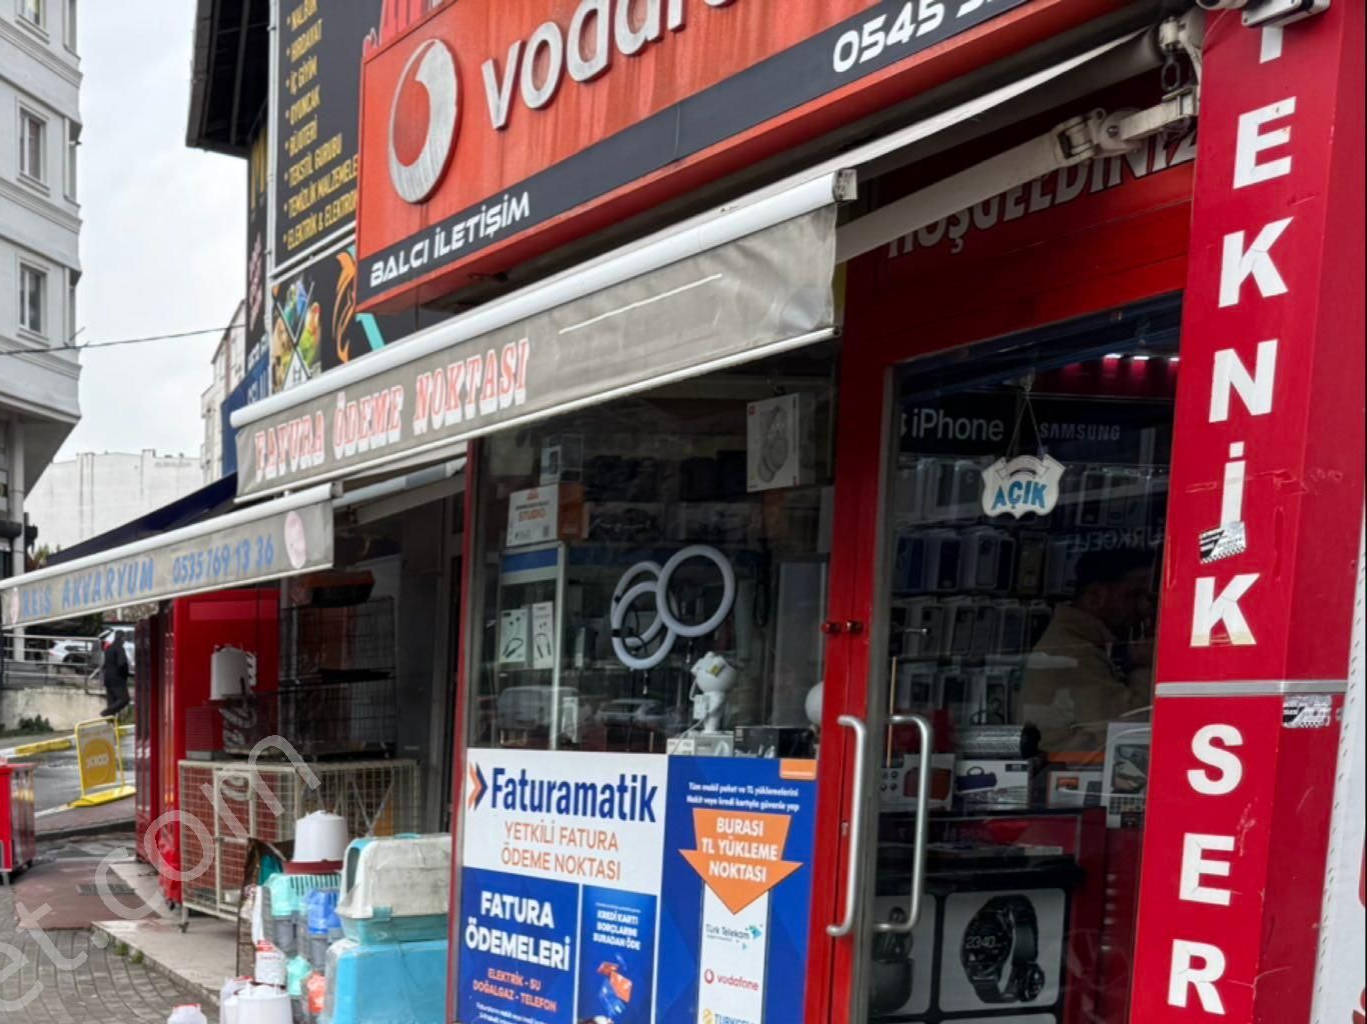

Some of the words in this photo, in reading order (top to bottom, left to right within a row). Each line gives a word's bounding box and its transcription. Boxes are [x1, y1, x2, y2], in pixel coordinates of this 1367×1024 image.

[833, 0, 946, 73] 0545
[369, 239, 429, 289] BALCI
[433, 191, 531, 260] İLETİŞİM
[333, 384, 405, 460] ÖDEME
[413, 338, 530, 436] NOKTASI
[911, 408, 1005, 441] iPhone
[1039, 422, 1121, 442] SAMSUNG
[991, 480, 1048, 510] AÇIK
[491, 766, 659, 824] Faturamatik
[504, 819, 555, 845] YETKİLİ
[558, 827, 619, 853] FATURA
[715, 816, 765, 837] BURASI
[501, 842, 551, 871] ÖDEME
[554, 855, 622, 881] NOKTASI
[701, 837, 716, 854] TL
[717, 835, 779, 862] YÜKLEME
[708, 860, 768, 883] NOKTASI
[480, 890, 555, 929] FATURA
[465, 916, 572, 972] ÖDEMELERİ
[473, 979, 515, 1001] DOĞALGAZ
[520, 992, 557, 1012] TELEFON
[487, 968, 524, 987] ELEKTRİK
[529, 979, 542, 991] SU
[716, 974, 760, 991] vodafone
